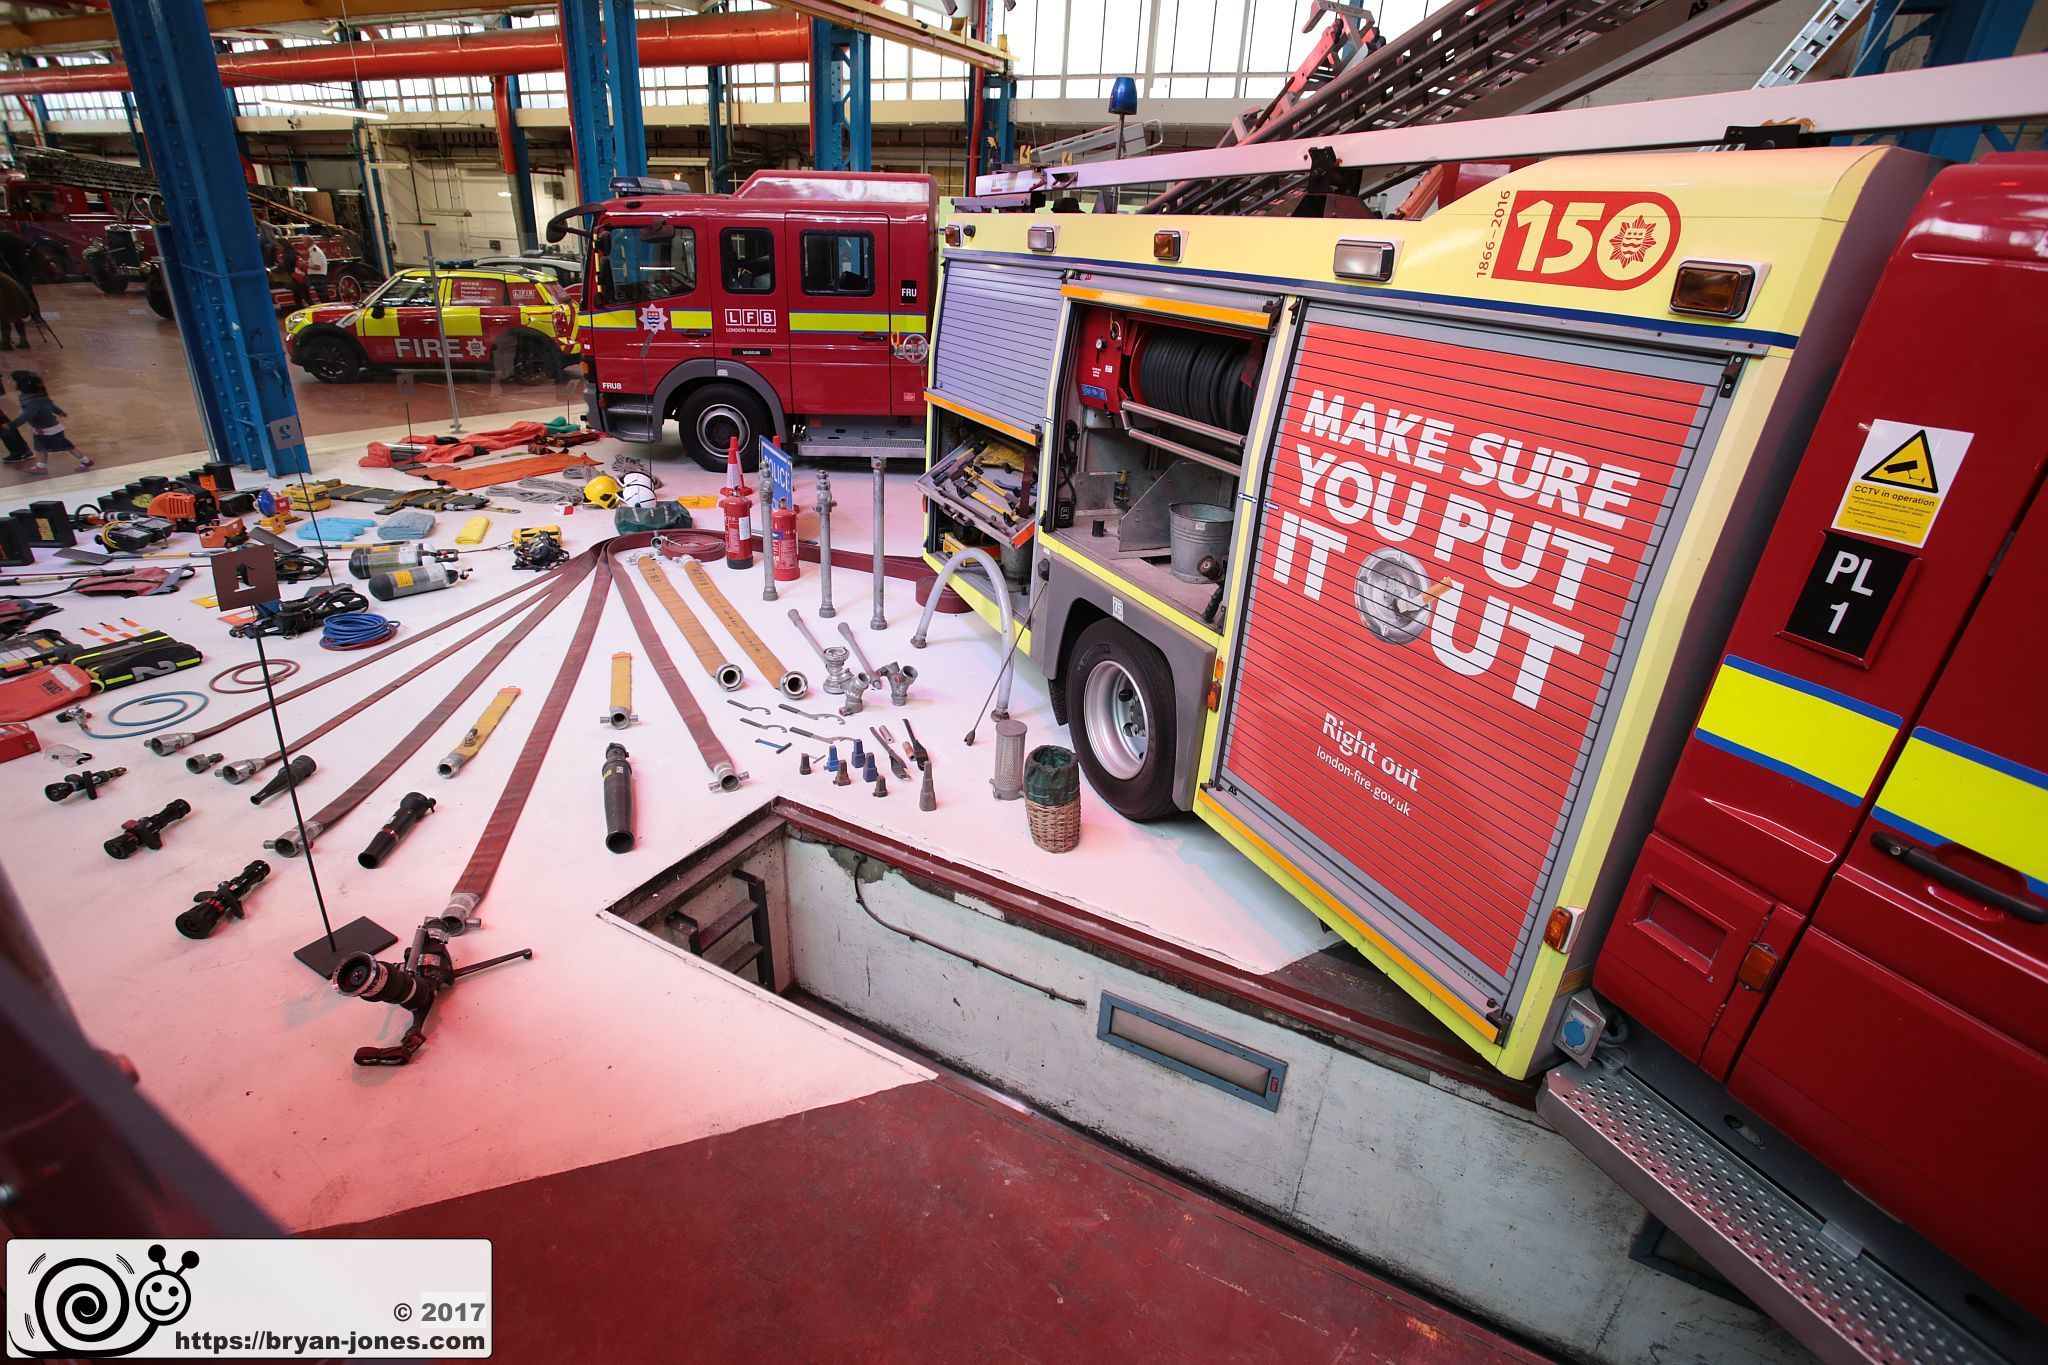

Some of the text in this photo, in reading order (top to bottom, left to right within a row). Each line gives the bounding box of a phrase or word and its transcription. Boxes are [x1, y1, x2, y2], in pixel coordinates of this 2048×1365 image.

[901, 288, 917, 297] FRU
[727, 310, 775, 325] LFB
[394, 338, 463, 358] FIRE
[1300, 389, 1641, 530] MAKE SURE
[1854, 485, 1881, 496] CCTV
[1881, 490, 1890, 498] in
[1892, 493, 1935, 508] operation
[1296, 443, 1615, 611] YOU PUT
[1273, 511, 1348, 601] IT
[1825, 550, 1874, 597] PL
[1113, 600, 1124, 617] 75
[1828, 601, 1850, 635] 1
[1322, 712, 1421, 792] Right out
[1316, 745, 1412, 817] london-fire.gov.uk
